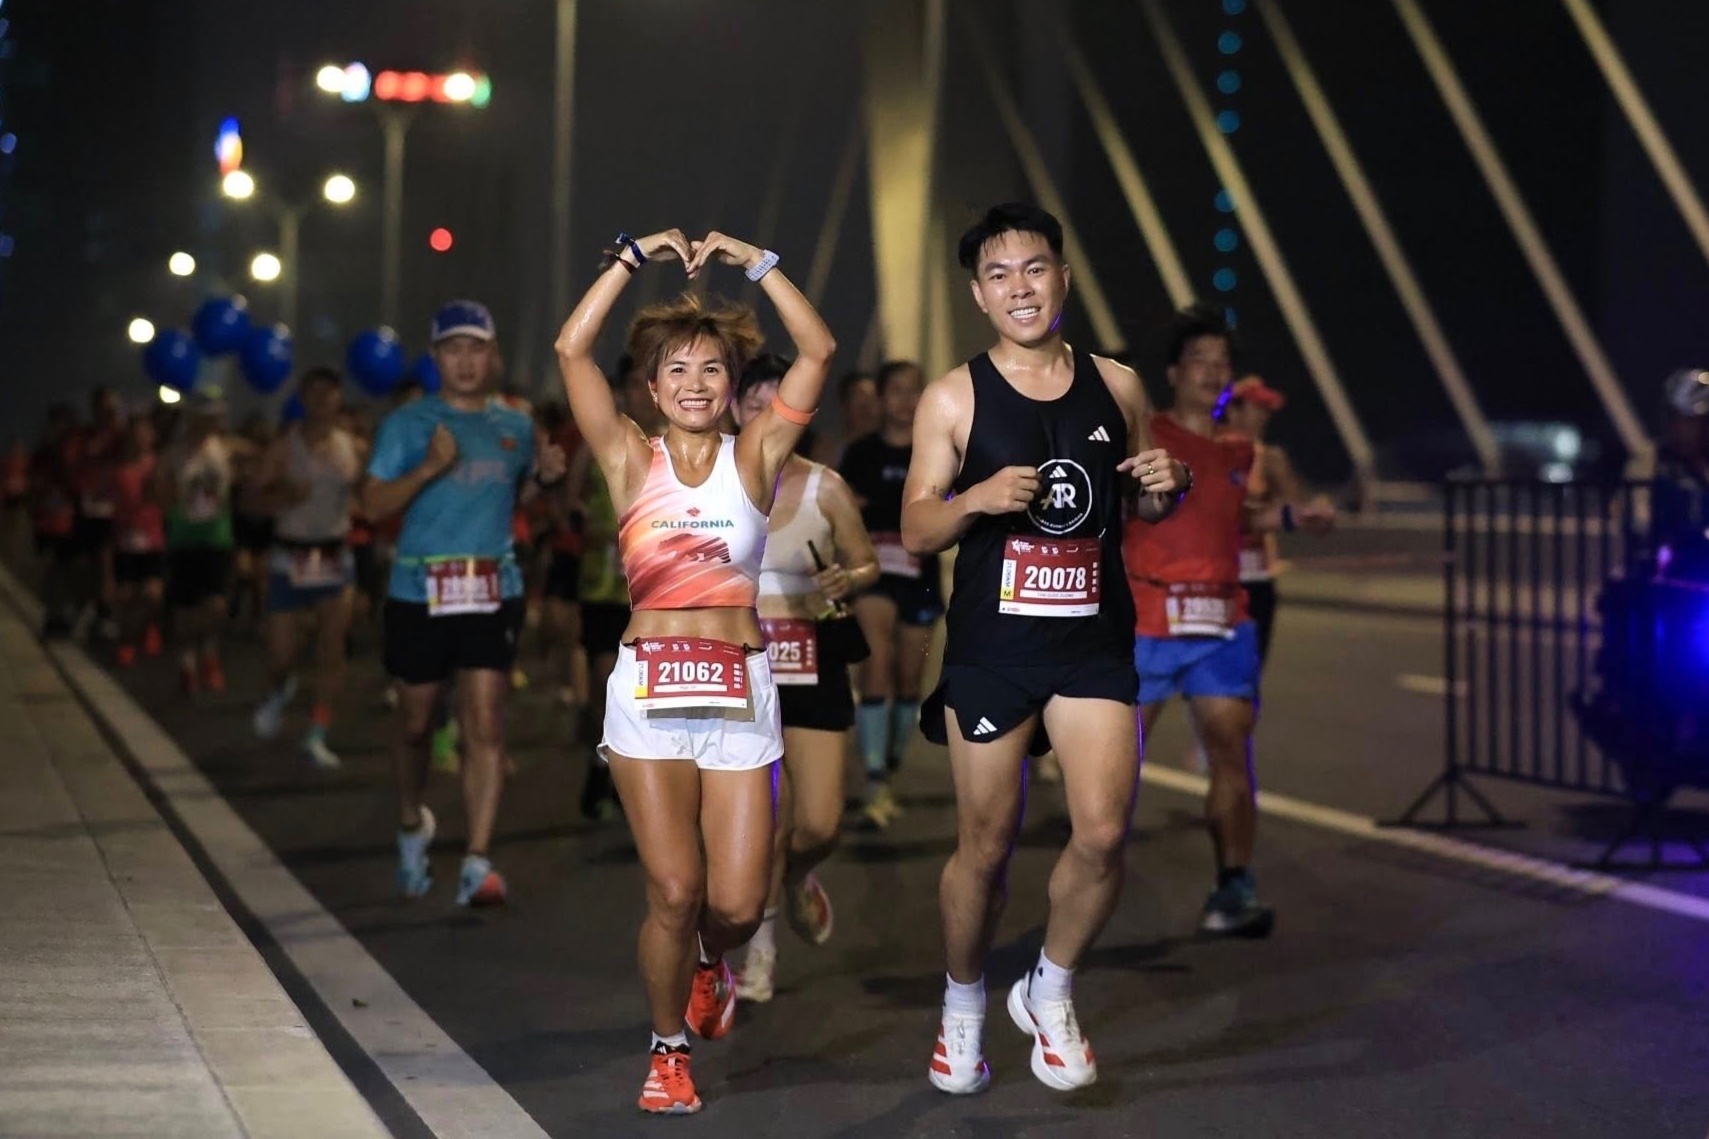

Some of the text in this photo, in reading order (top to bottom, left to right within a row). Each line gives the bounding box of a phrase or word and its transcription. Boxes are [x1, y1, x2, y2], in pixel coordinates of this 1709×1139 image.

[651, 519, 734, 529] CALIFORNIA
[1024, 565, 1086, 590] 20078
[766, 641, 801, 661] 025
[658, 661, 724, 683] 21062
